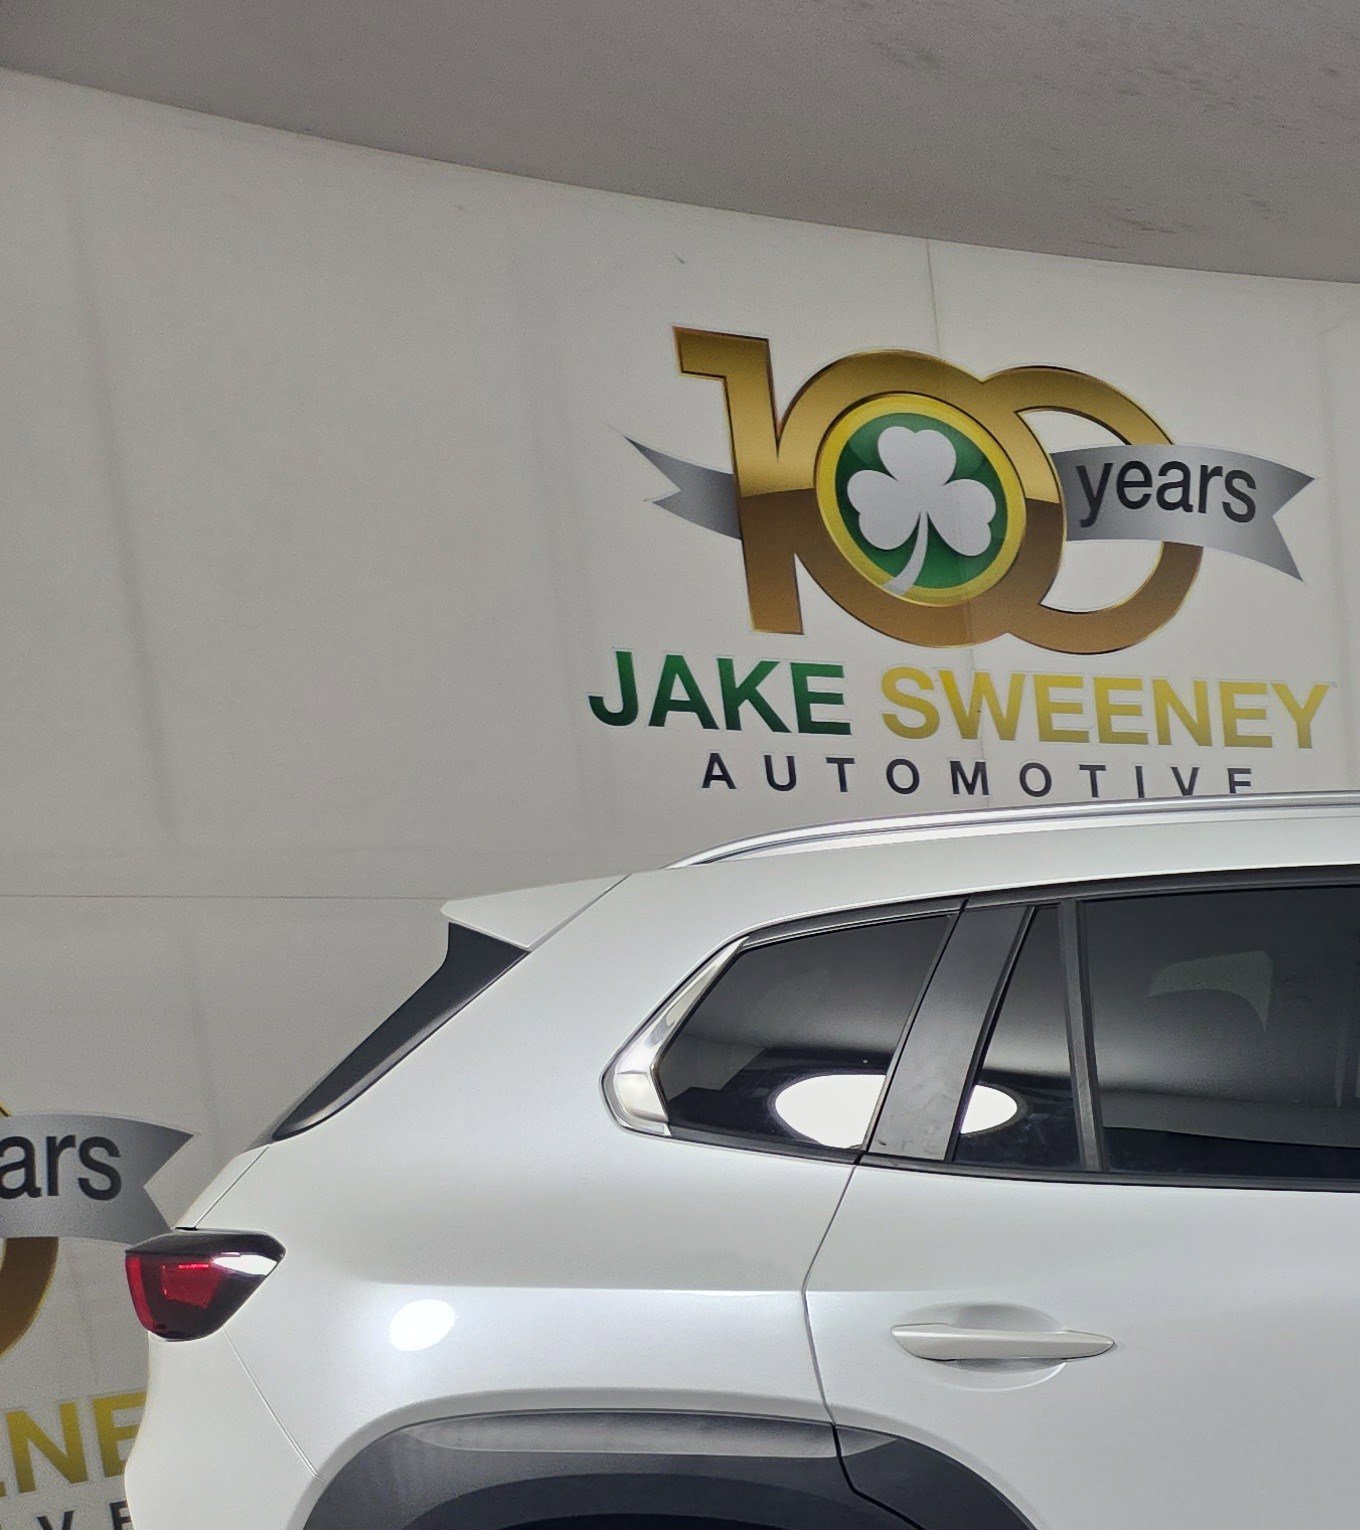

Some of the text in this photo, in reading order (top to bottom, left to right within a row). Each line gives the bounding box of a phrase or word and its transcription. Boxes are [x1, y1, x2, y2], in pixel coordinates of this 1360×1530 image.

[671, 325, 1204, 655] 100
[1076, 458, 1258, 527] years
[588, 649, 1331, 751] JAKE SWEENEY
[701, 751, 1254, 799] AUTOMOTIVE
